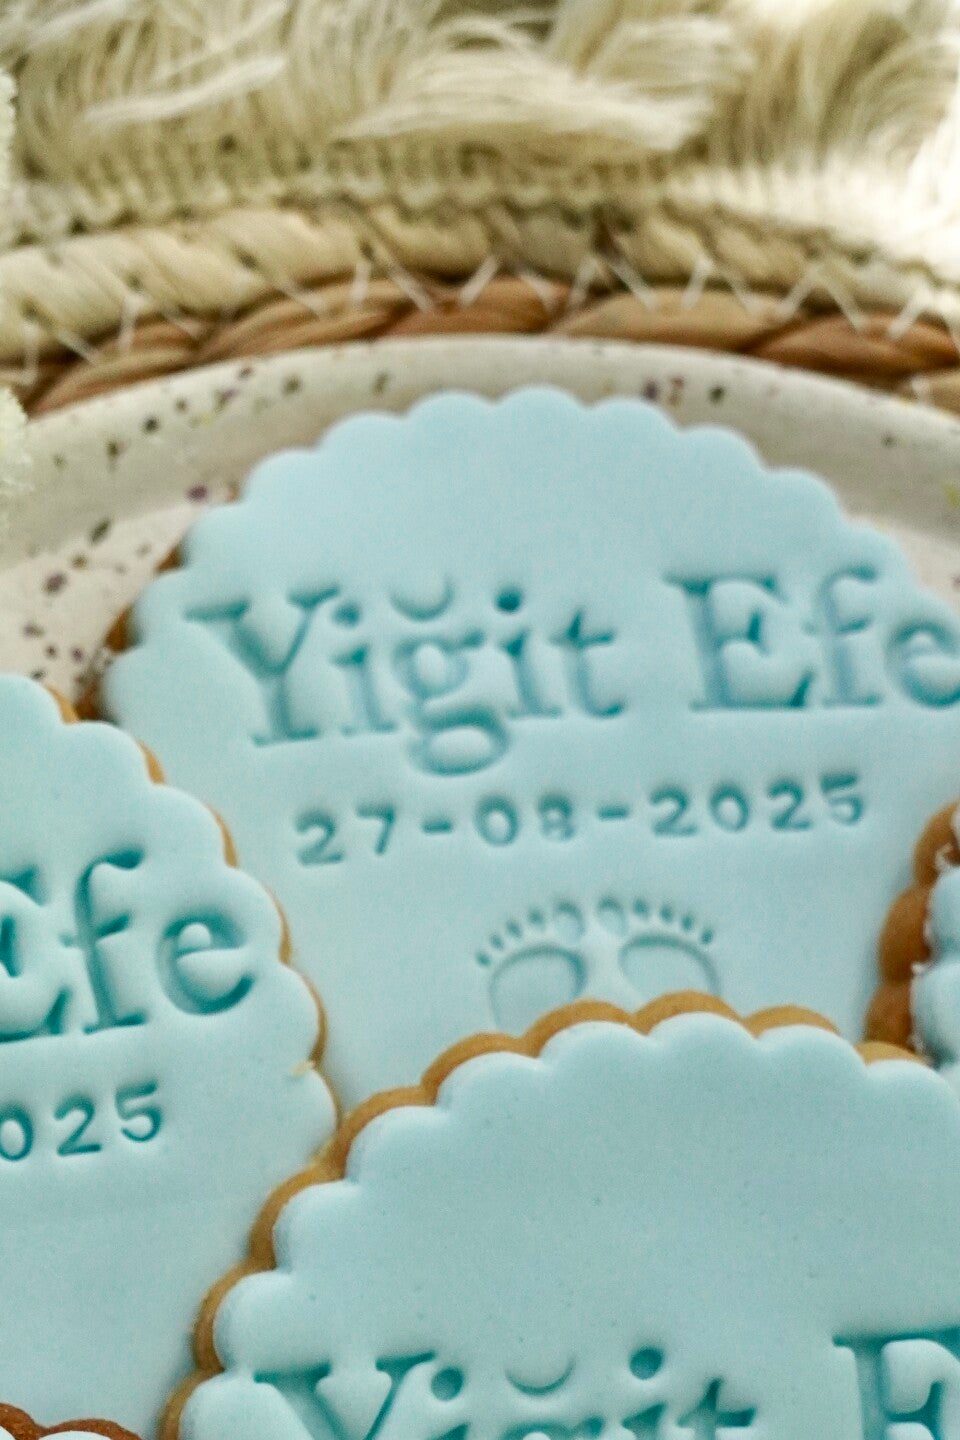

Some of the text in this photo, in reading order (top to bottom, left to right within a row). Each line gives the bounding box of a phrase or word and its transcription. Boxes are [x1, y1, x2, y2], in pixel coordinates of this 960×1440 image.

[182, 562, 960, 776] Yiğit Efe
[294, 768, 866, 866] 27-08-2025
